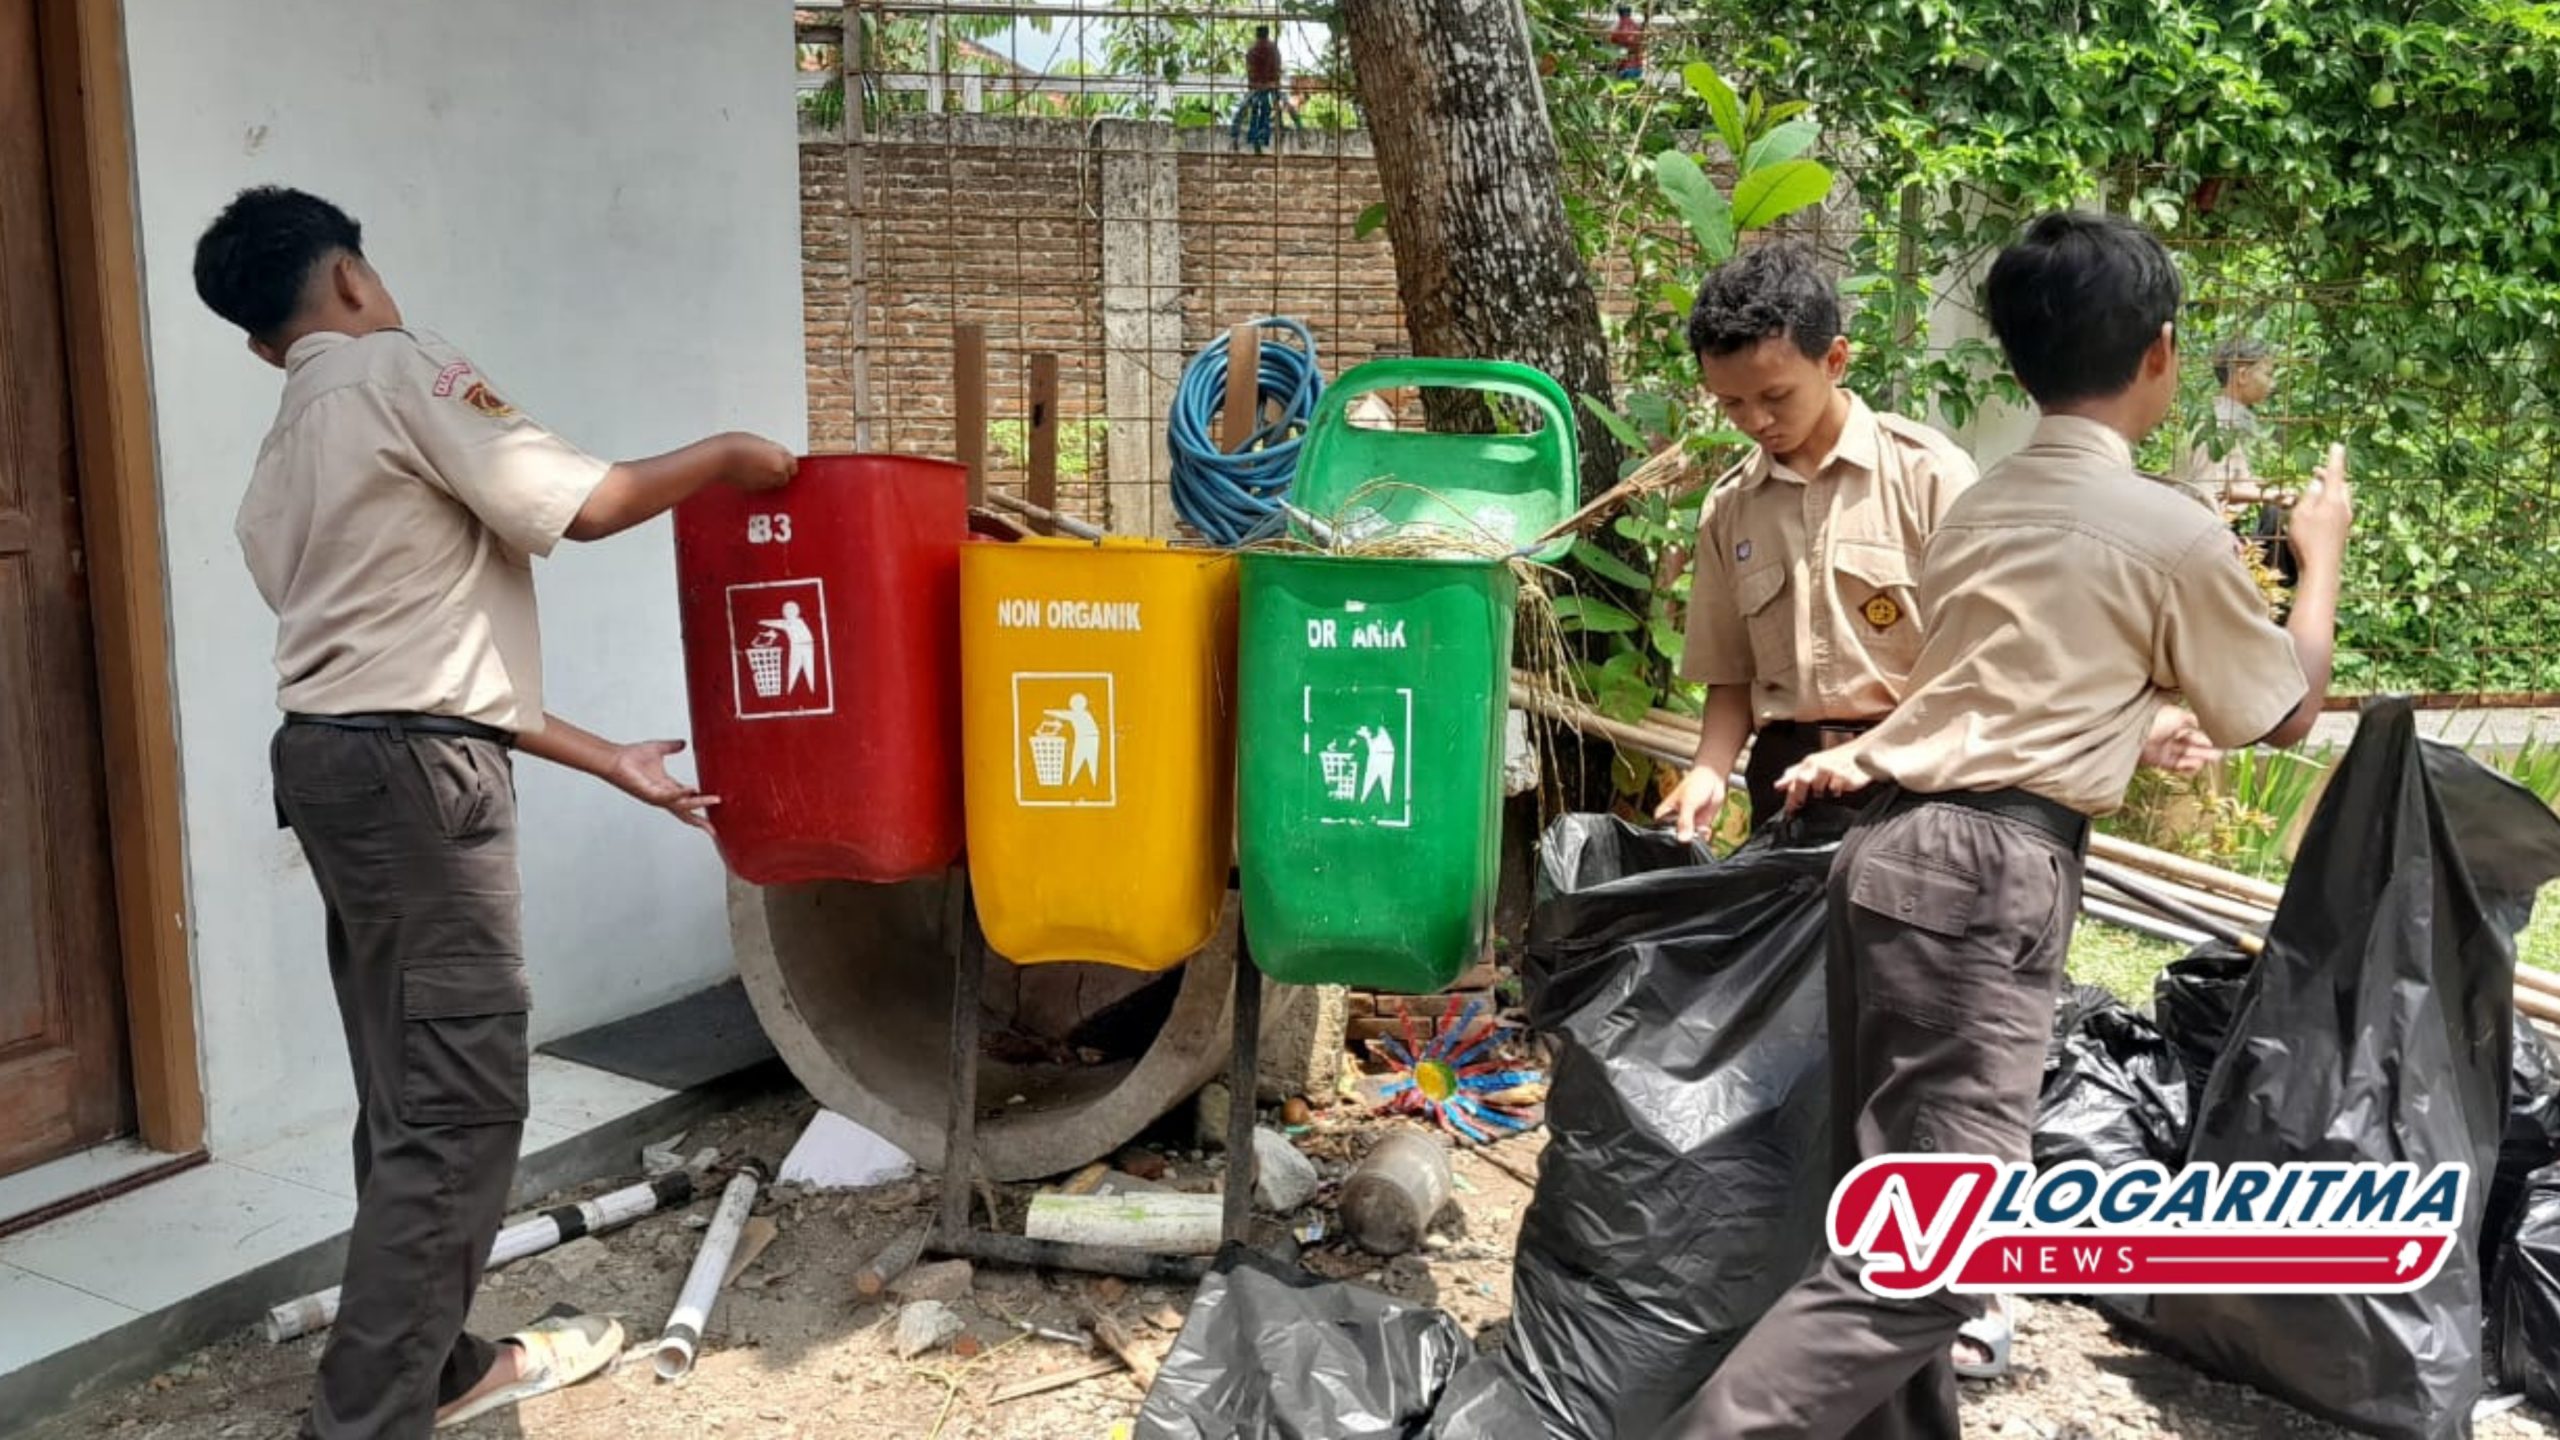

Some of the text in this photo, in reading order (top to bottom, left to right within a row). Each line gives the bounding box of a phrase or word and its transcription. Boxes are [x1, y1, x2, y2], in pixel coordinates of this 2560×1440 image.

[748, 513, 792, 544] B3
[998, 599, 1141, 630] NON ORGANIK
